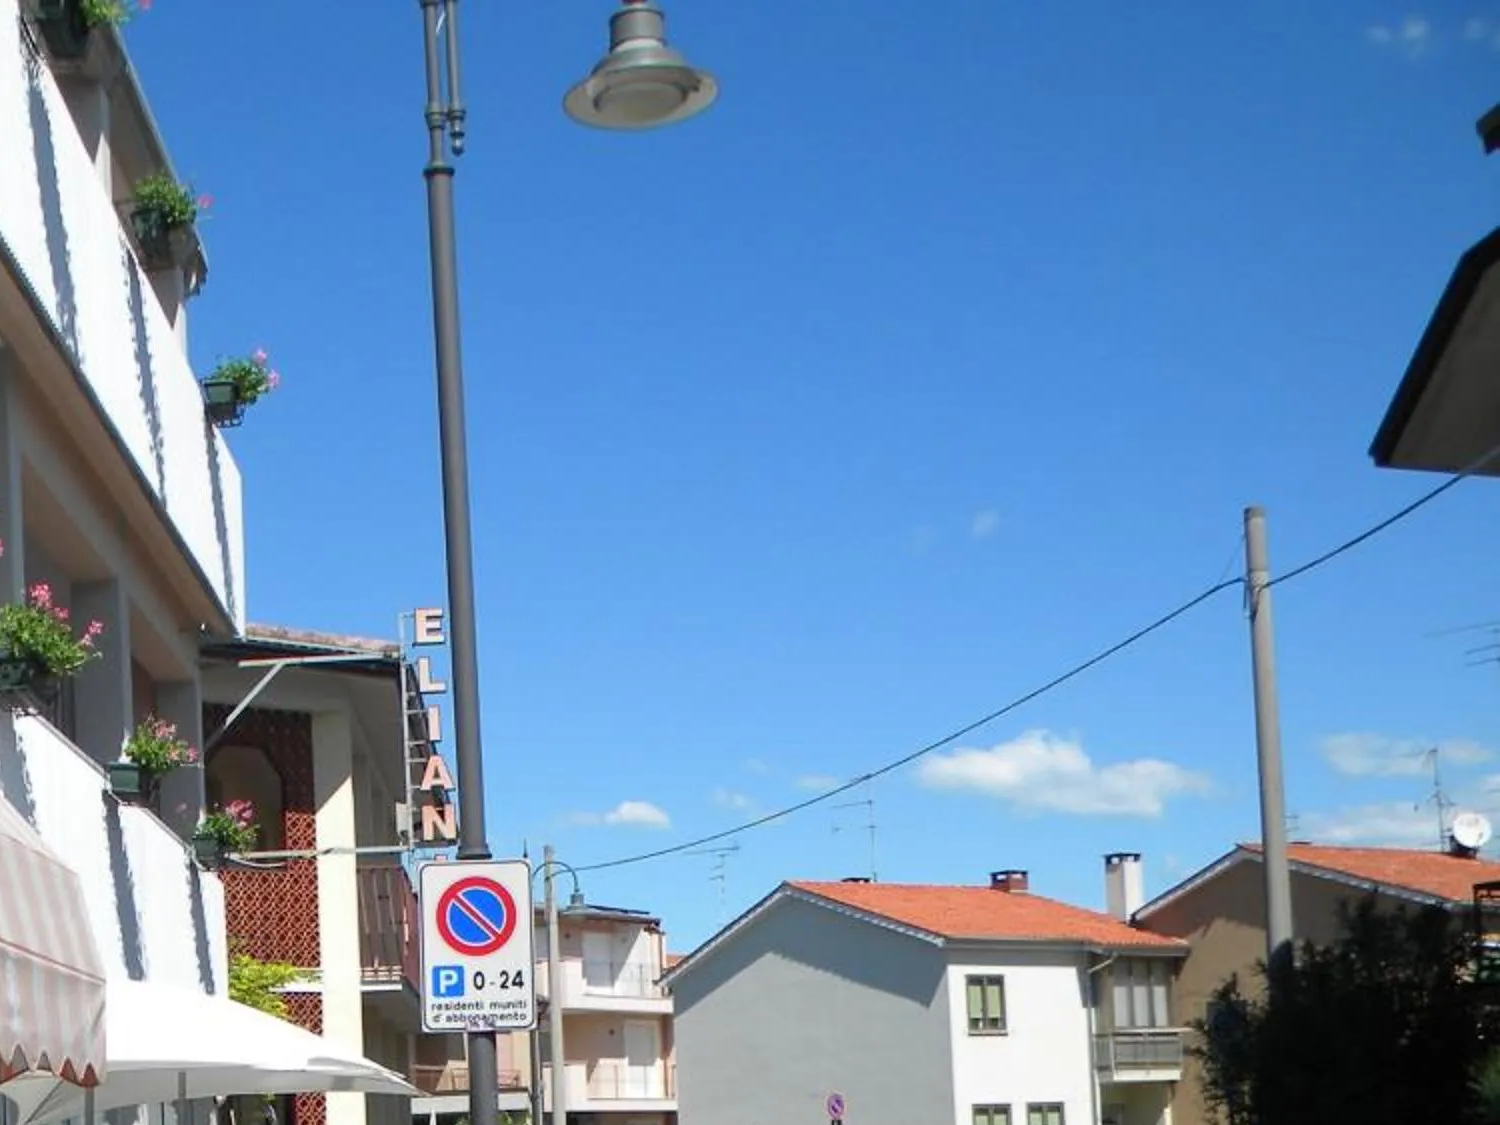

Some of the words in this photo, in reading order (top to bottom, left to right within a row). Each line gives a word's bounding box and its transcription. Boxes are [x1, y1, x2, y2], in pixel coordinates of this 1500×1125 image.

[414, 608, 457, 861] ELIAN
[438, 969, 458, 994] P
[432, 1001, 484, 1010] residenti
[489, 1000, 527, 1009] muniti
